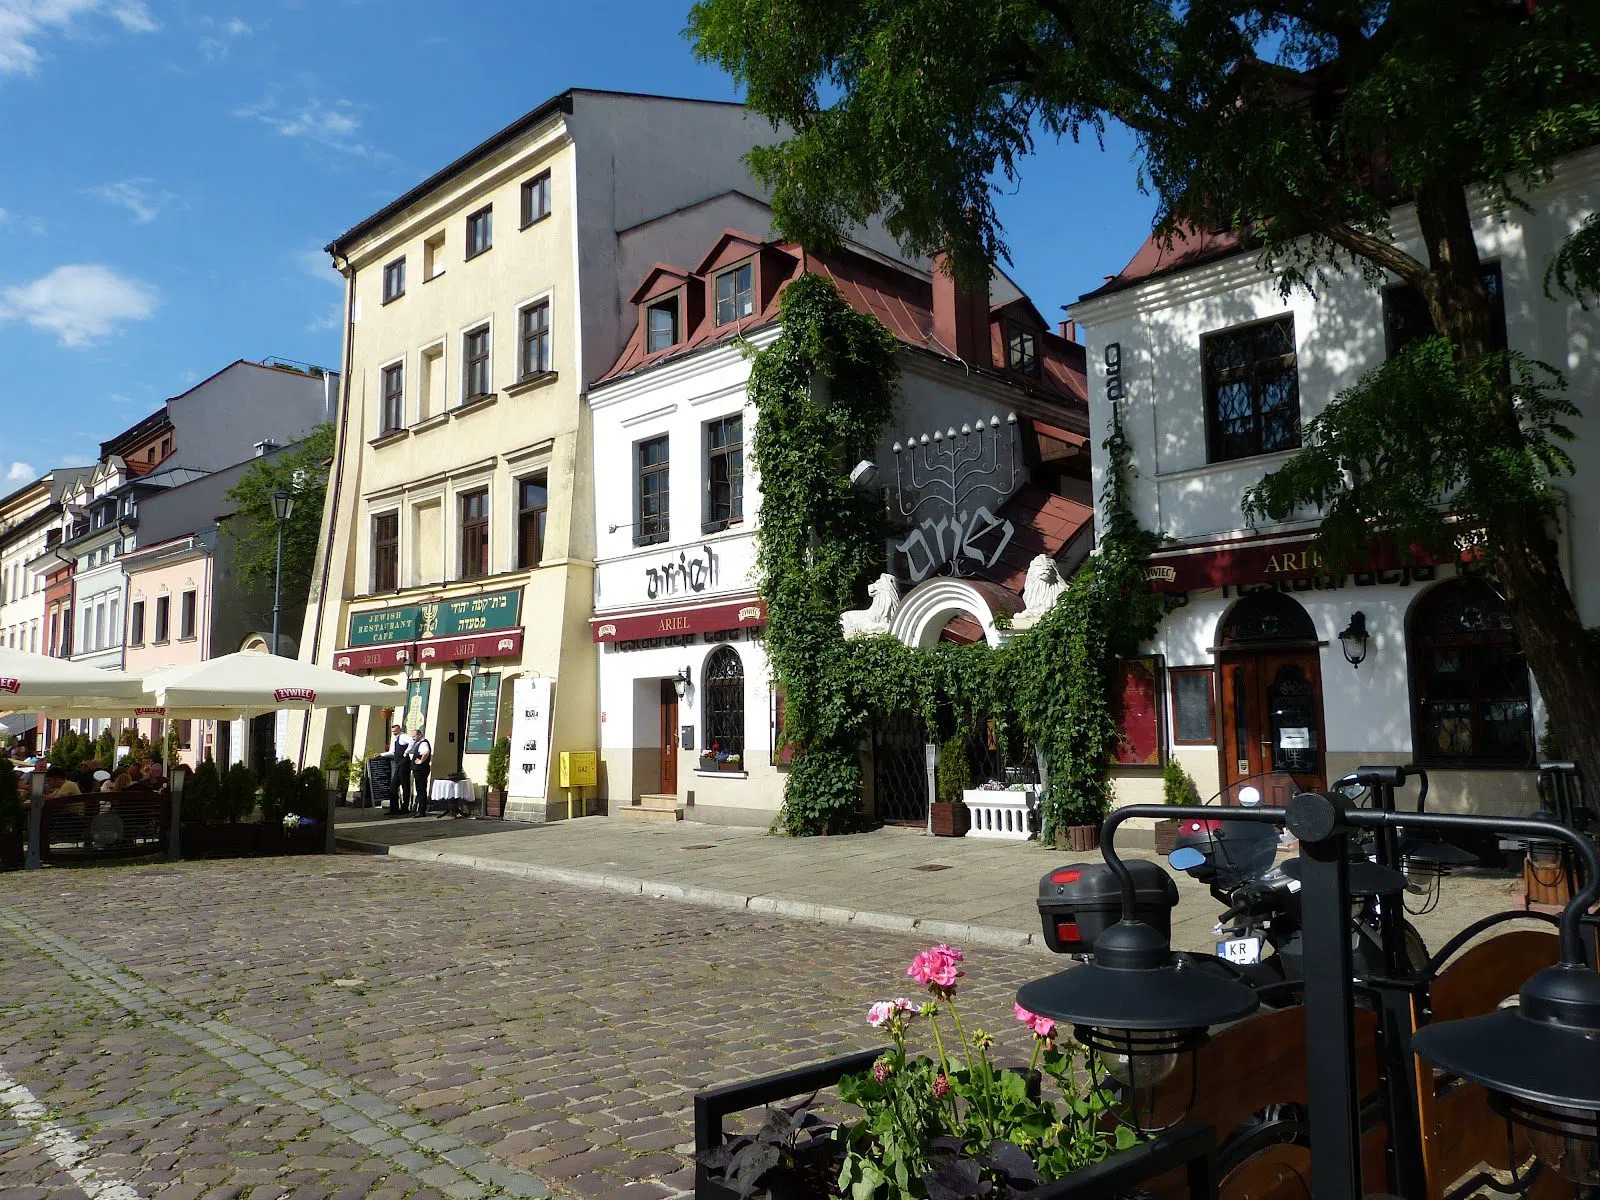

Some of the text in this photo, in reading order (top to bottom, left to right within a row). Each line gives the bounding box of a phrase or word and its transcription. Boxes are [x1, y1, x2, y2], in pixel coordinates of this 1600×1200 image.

[368, 611, 402, 623] JEWISH
[358, 619, 413, 634] RESTAURANT
[658, 616, 690, 632] ARIEL
[373, 631, 394, 642] CAFE
[454, 643, 476, 656] ARIEL
[362, 653, 383, 665] ARIEL
[577, 765, 588, 773] GAZ
[1230, 943, 1246, 956] KR
